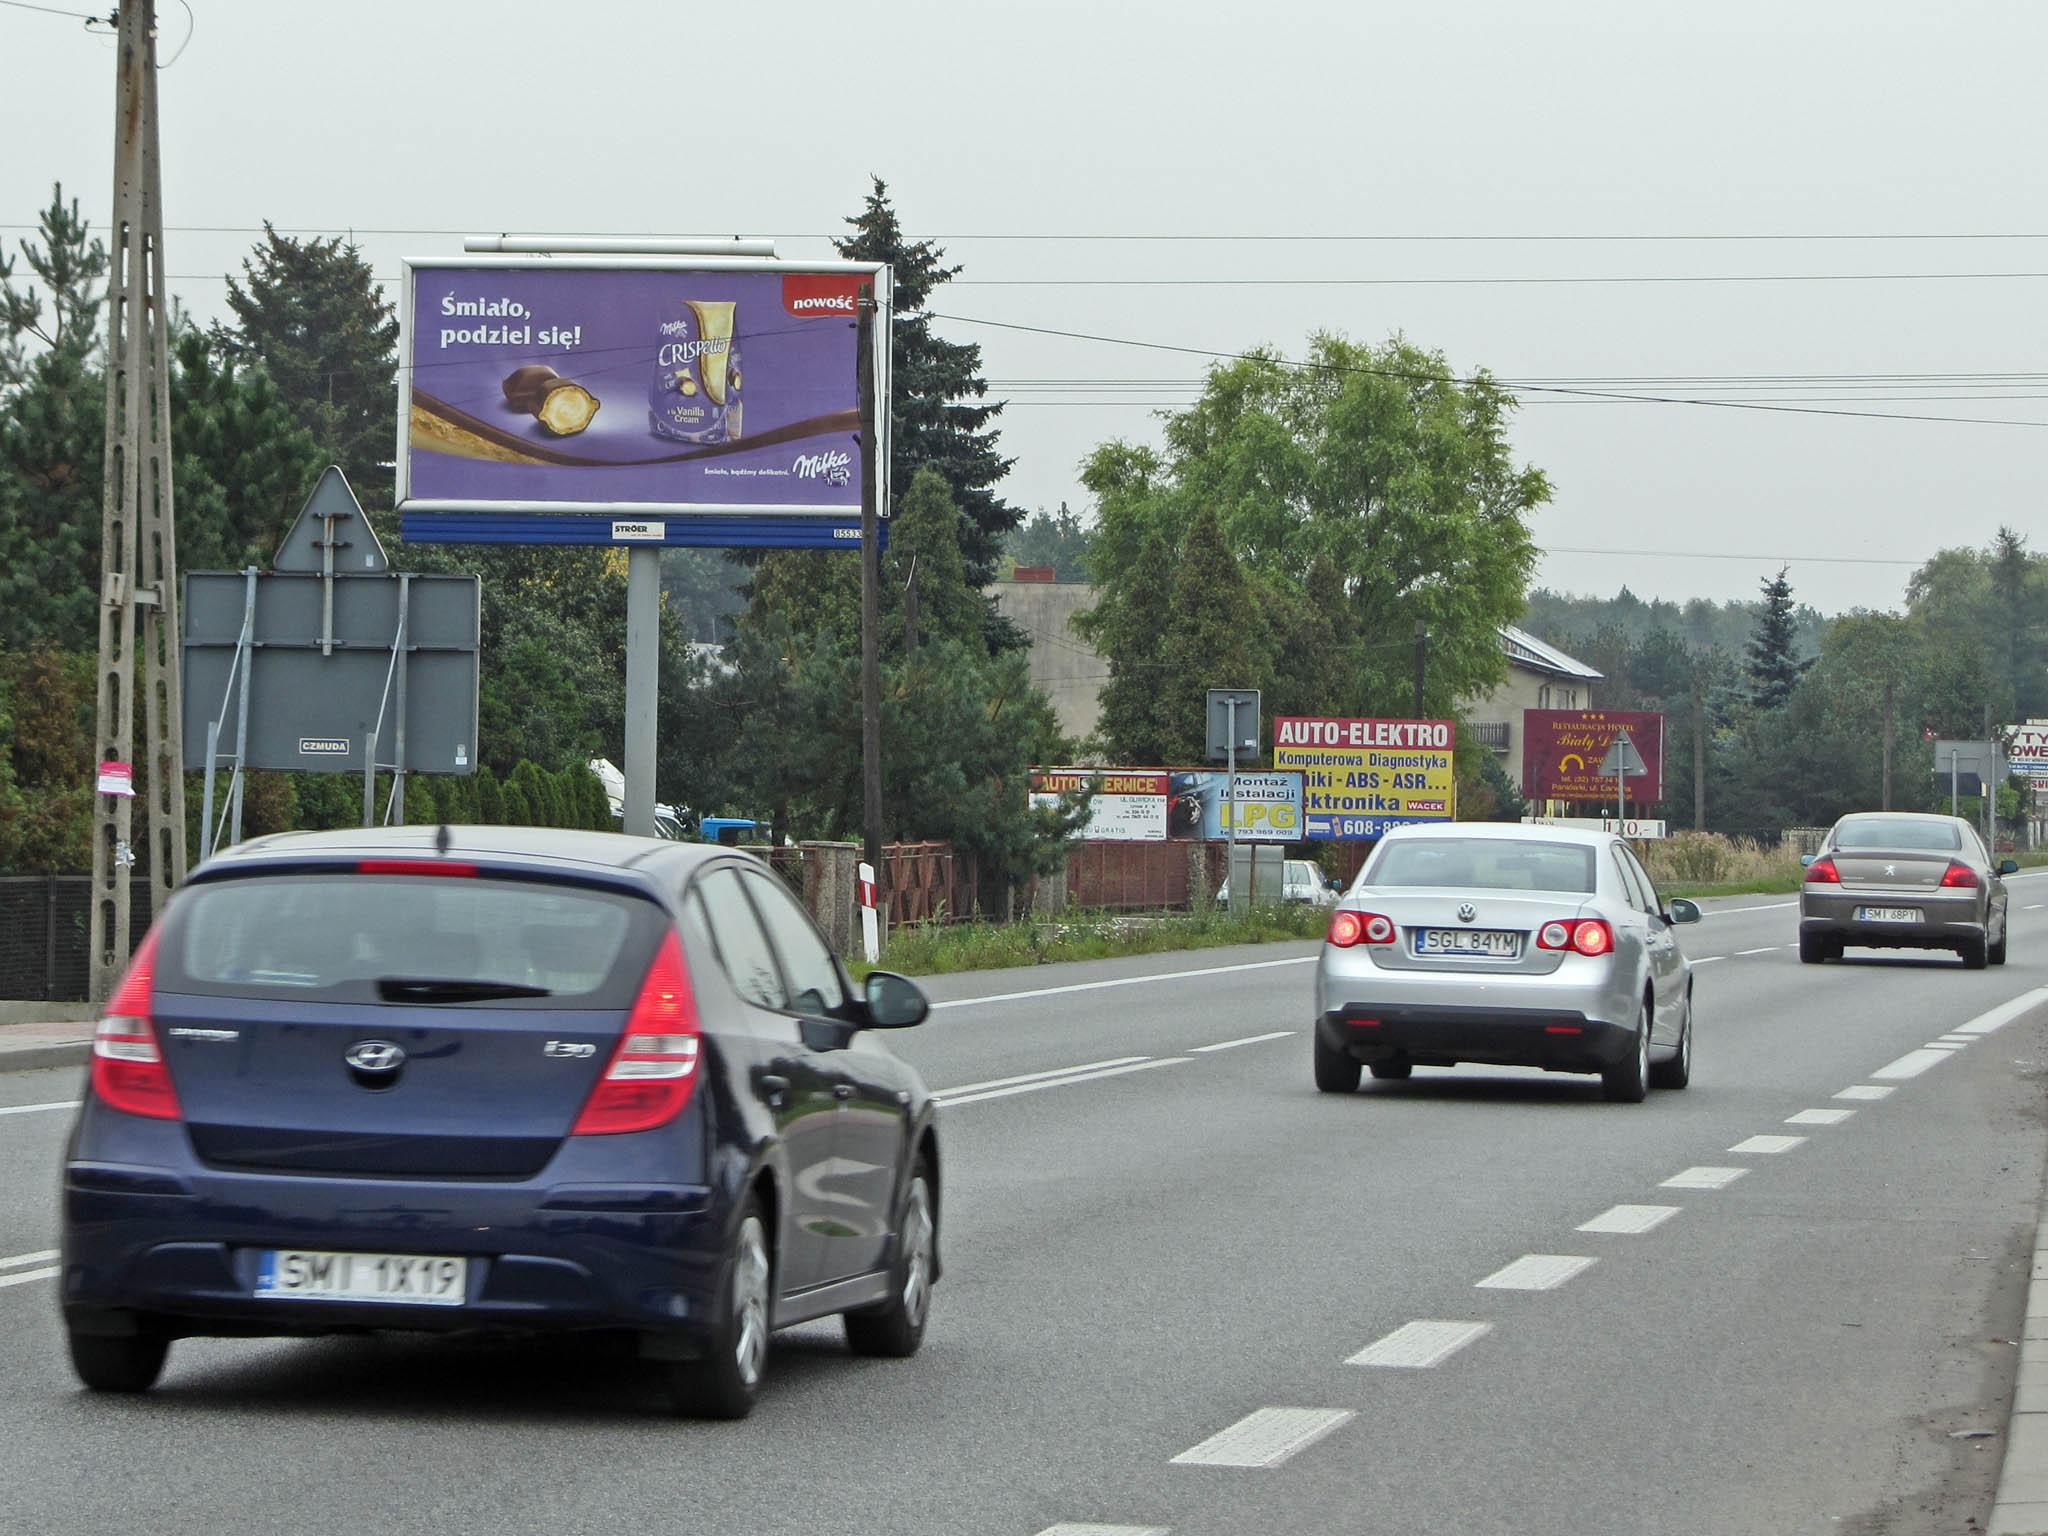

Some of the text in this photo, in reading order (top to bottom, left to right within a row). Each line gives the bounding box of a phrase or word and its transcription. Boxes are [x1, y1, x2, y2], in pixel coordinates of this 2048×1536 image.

[441, 291, 531, 320] Śmiało,
[793, 294, 854, 310] nowość
[440, 325, 581, 350] podziel się!
[674, 414, 700, 424] Cream
[676, 406, 705, 417] Vanilla
[793, 450, 851, 478] Milka
[1279, 722, 1448, 747] AUTO-ELEKTRO
[302, 742, 347, 751] CZMUDA
[1278, 751, 1447, 771] Komputerowa Diagnostyka
[1102, 777, 1157, 793] ERWICE
[1345, 772, 1380, 789] ABS
[1392, 773, 1447, 790] ASR...
[1408, 801, 1444, 810] WACEK
[1220, 803, 1296, 829] LPG
[1868, 909, 1886, 919] SMI
[1427, 931, 1514, 950] SGL 84YM
[281, 1254, 456, 1294] SMI 1X19
